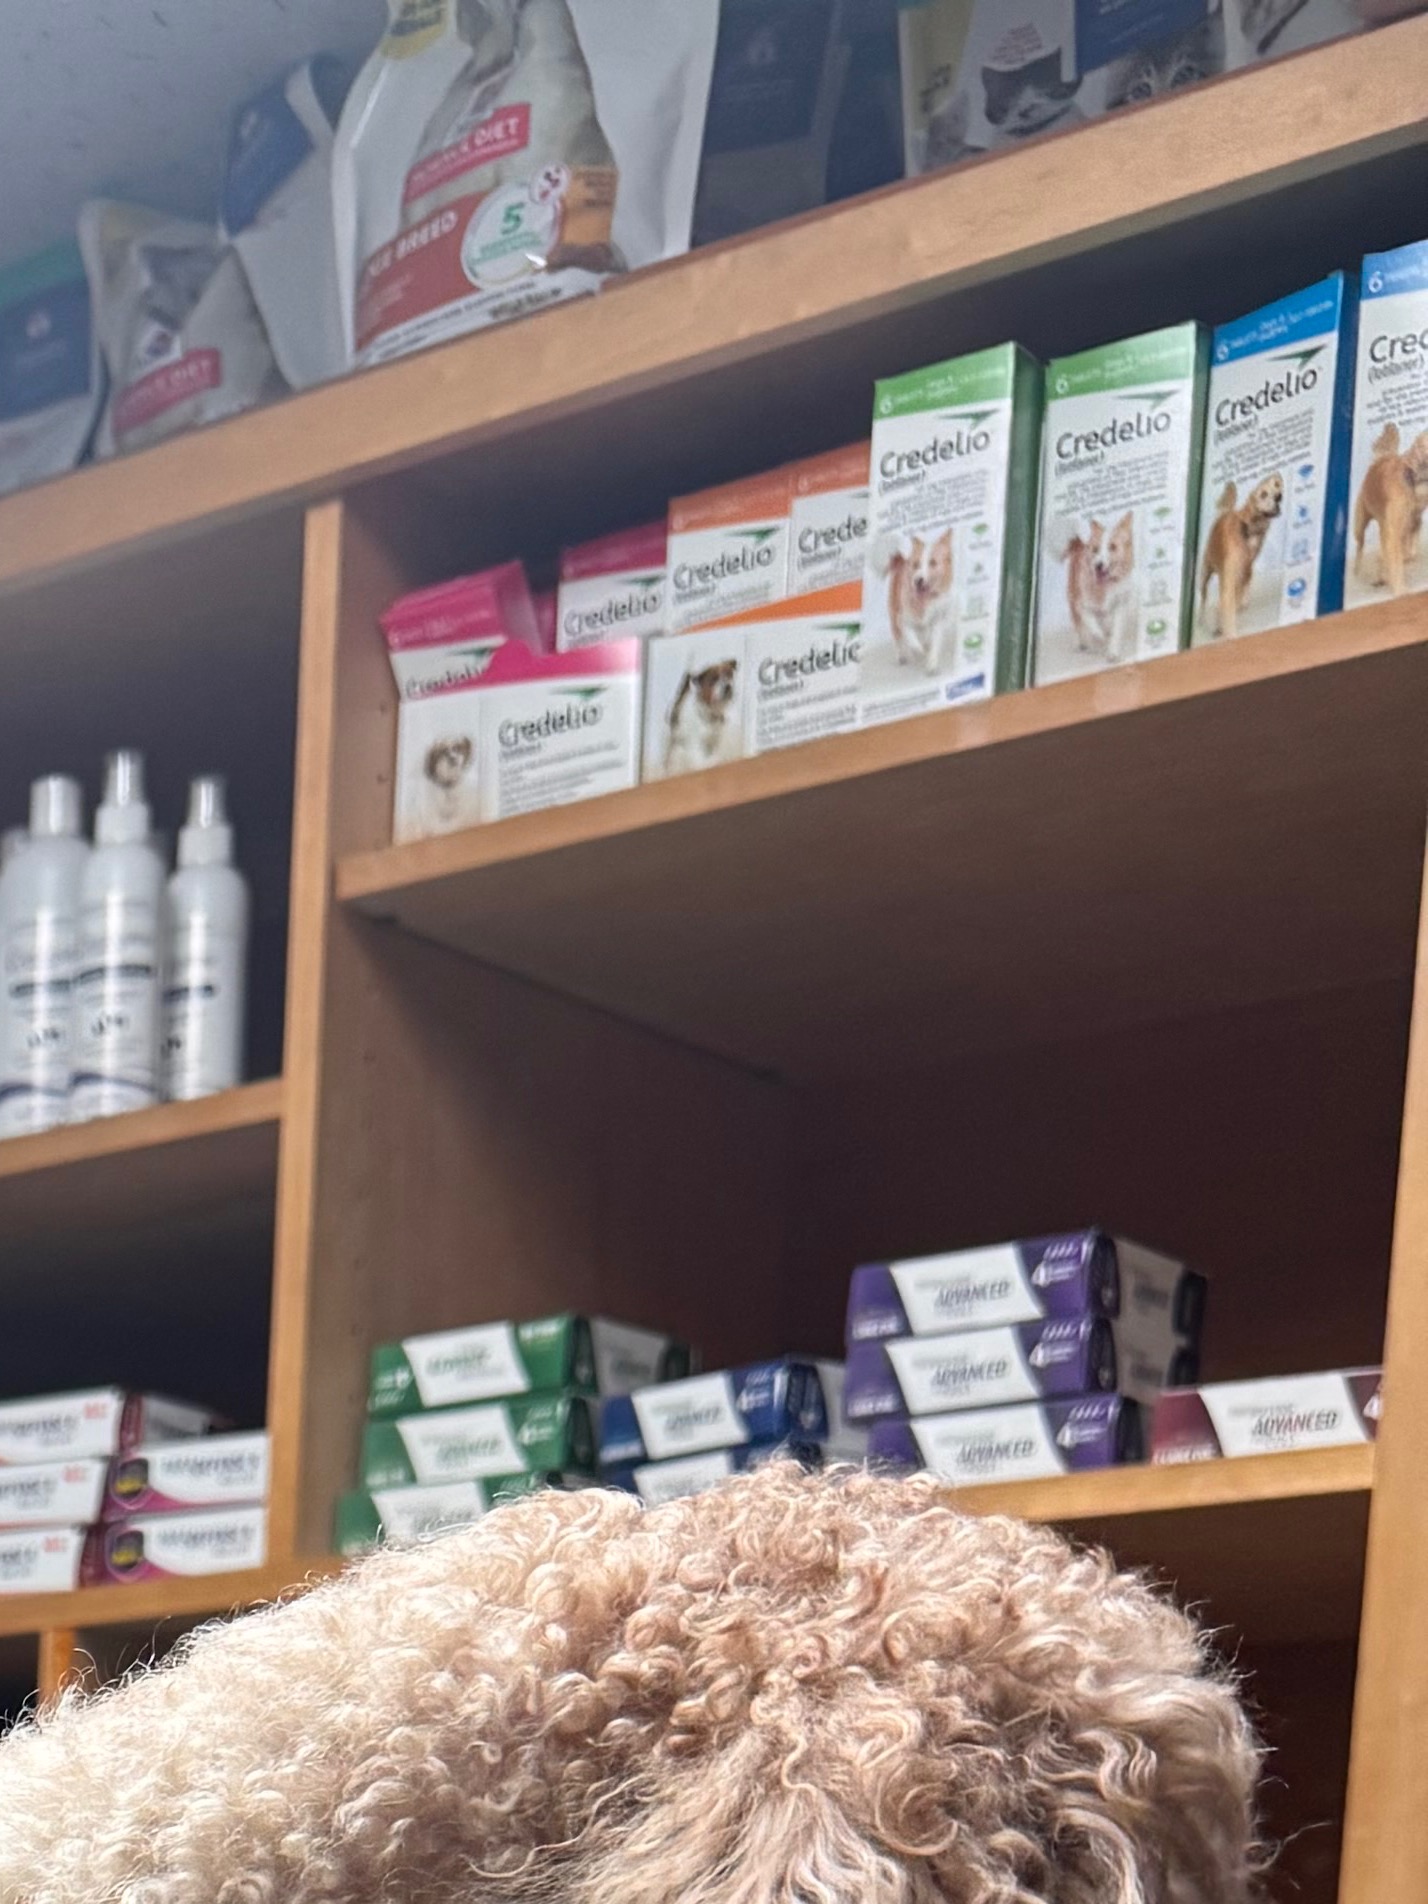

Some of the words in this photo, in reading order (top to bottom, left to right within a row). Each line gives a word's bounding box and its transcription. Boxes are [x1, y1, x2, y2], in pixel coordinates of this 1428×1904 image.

[1215, 368, 1318, 427] Credelio
[879, 430, 991, 479] Credelio
[1056, 411, 1172, 460] Credelio
[797, 513, 868, 555] Crede
[672, 545, 775, 592] Credelio
[497, 702, 605, 749] Credelio
